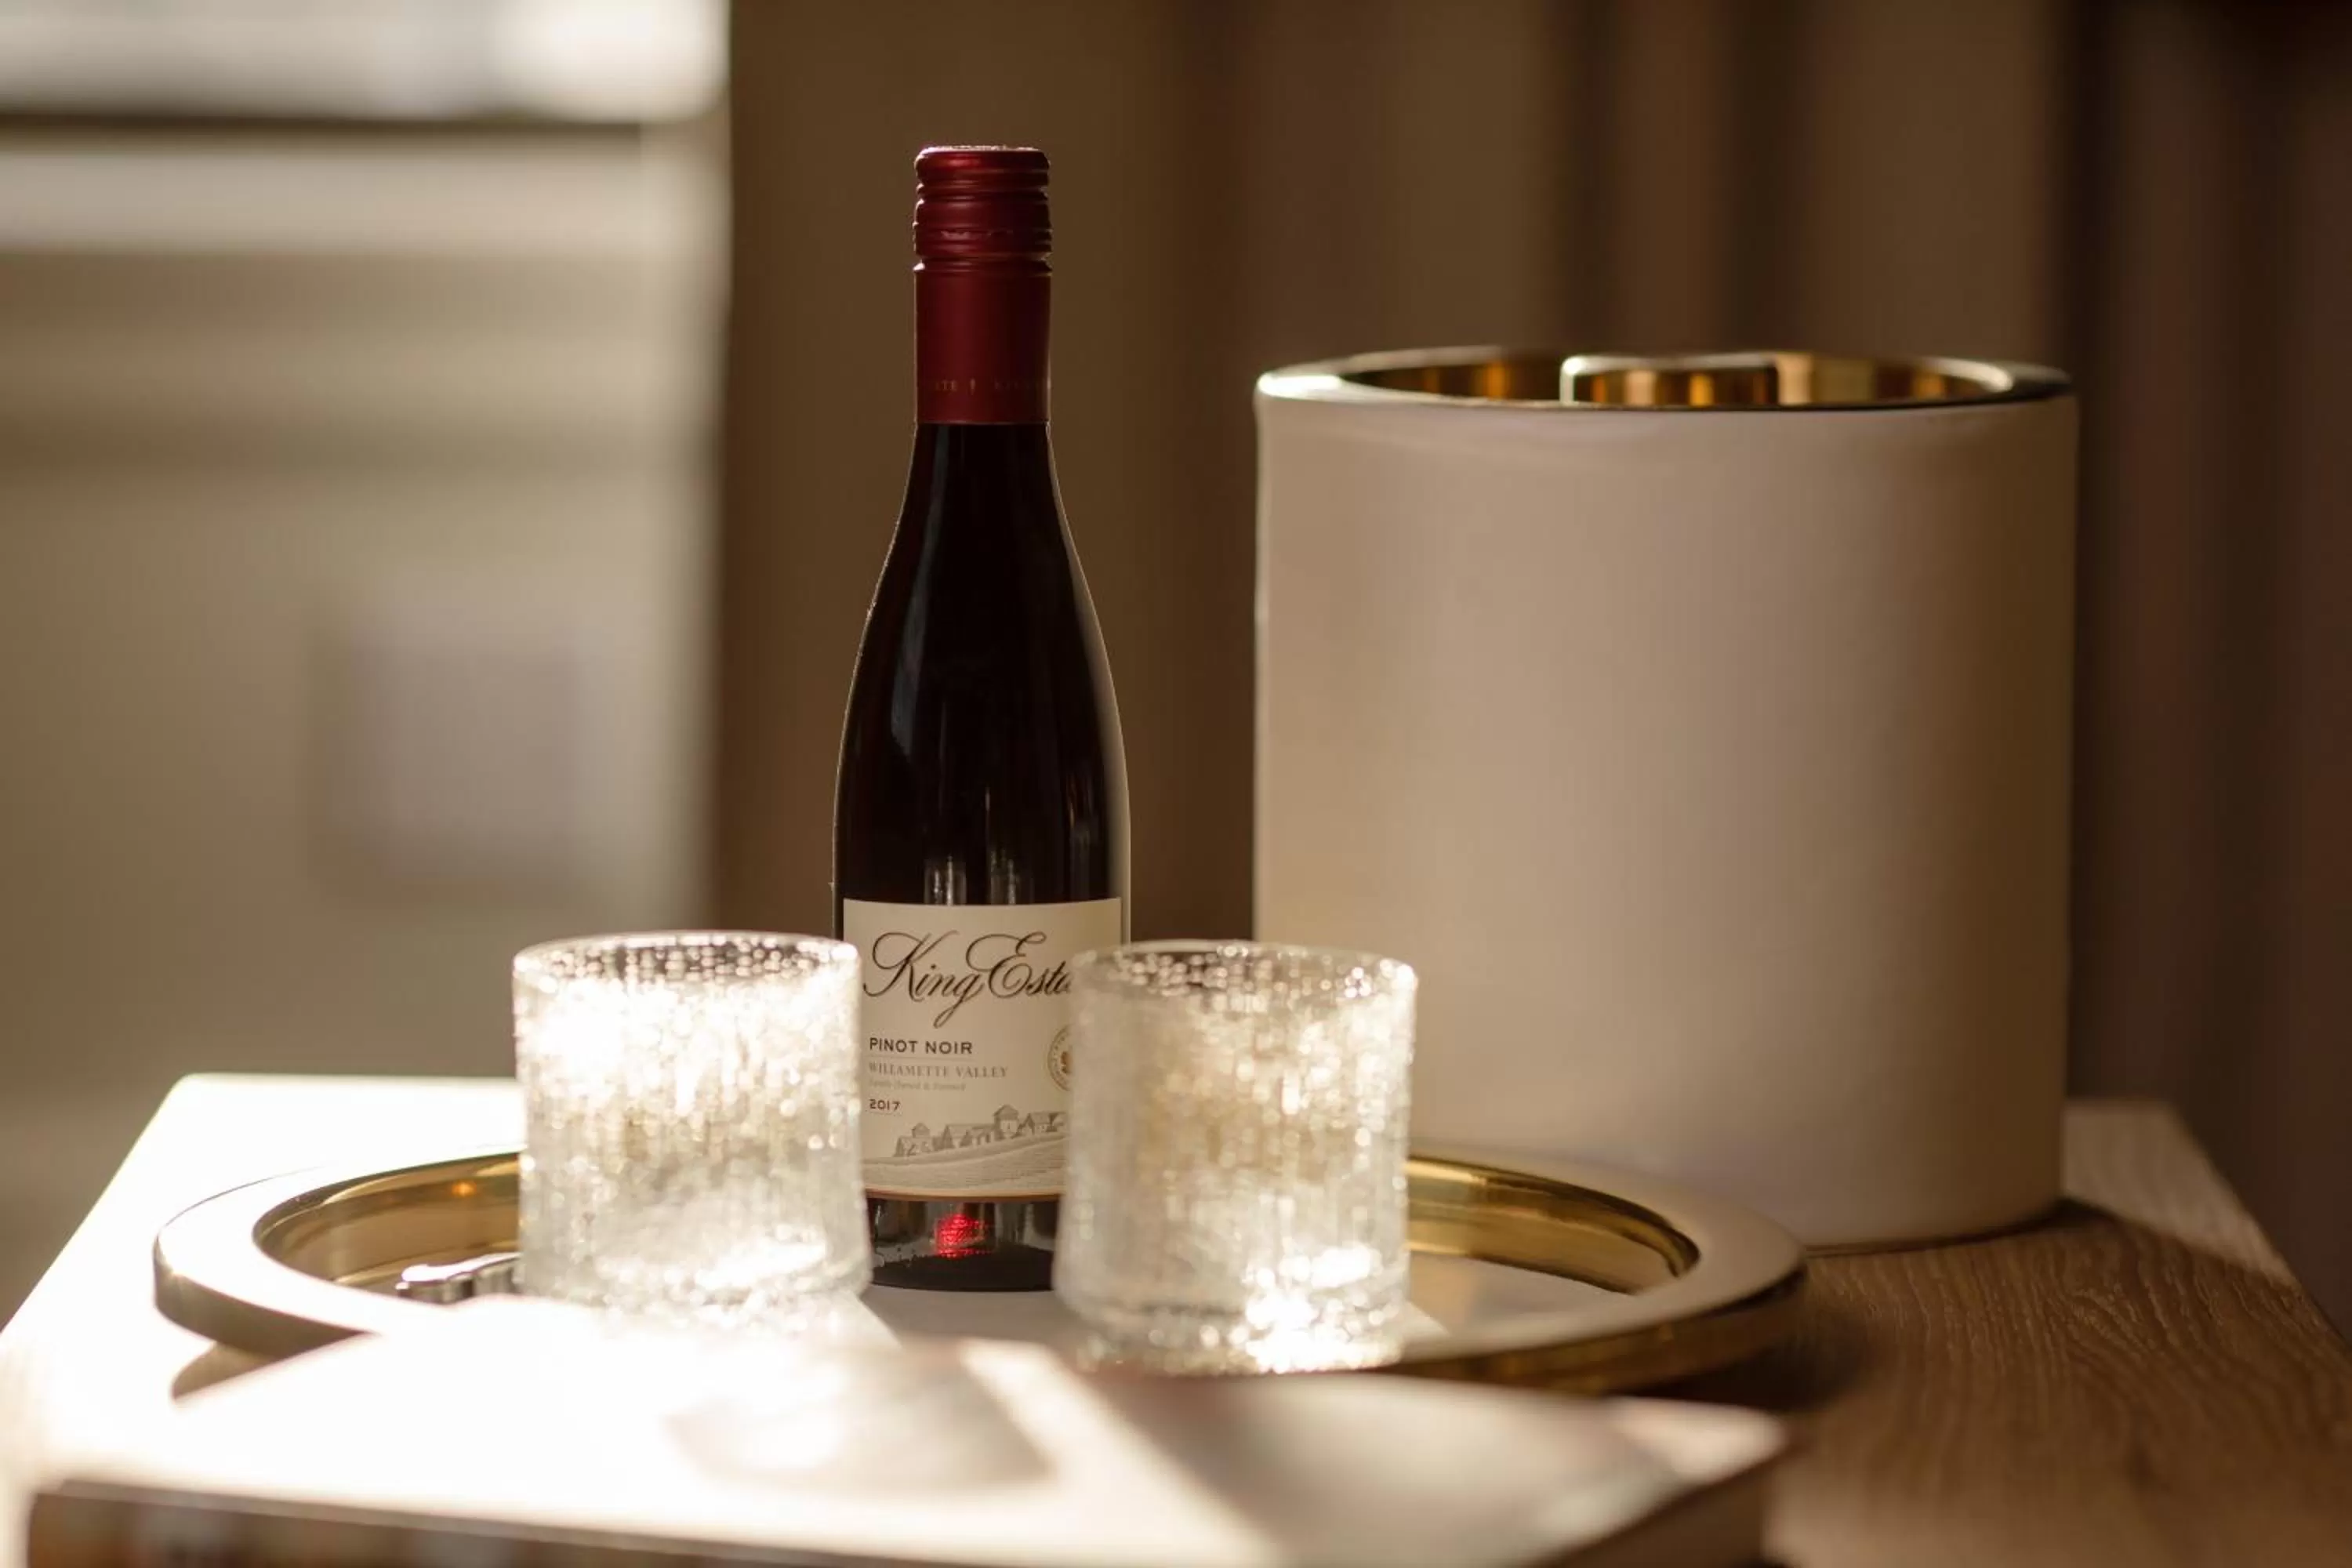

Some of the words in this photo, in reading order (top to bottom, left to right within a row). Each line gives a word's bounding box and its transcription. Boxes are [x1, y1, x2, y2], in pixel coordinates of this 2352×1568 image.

[862, 930, 985, 1029] King
[966, 931, 1072, 998] Esta
[869, 1037, 918, 1053] PINOT
[925, 1040, 973, 1054] NOIR
[868, 1062, 949, 1077] WILLAMETTE
[956, 1065, 1008, 1078] VALLEY
[869, 1098, 901, 1112] 2017
